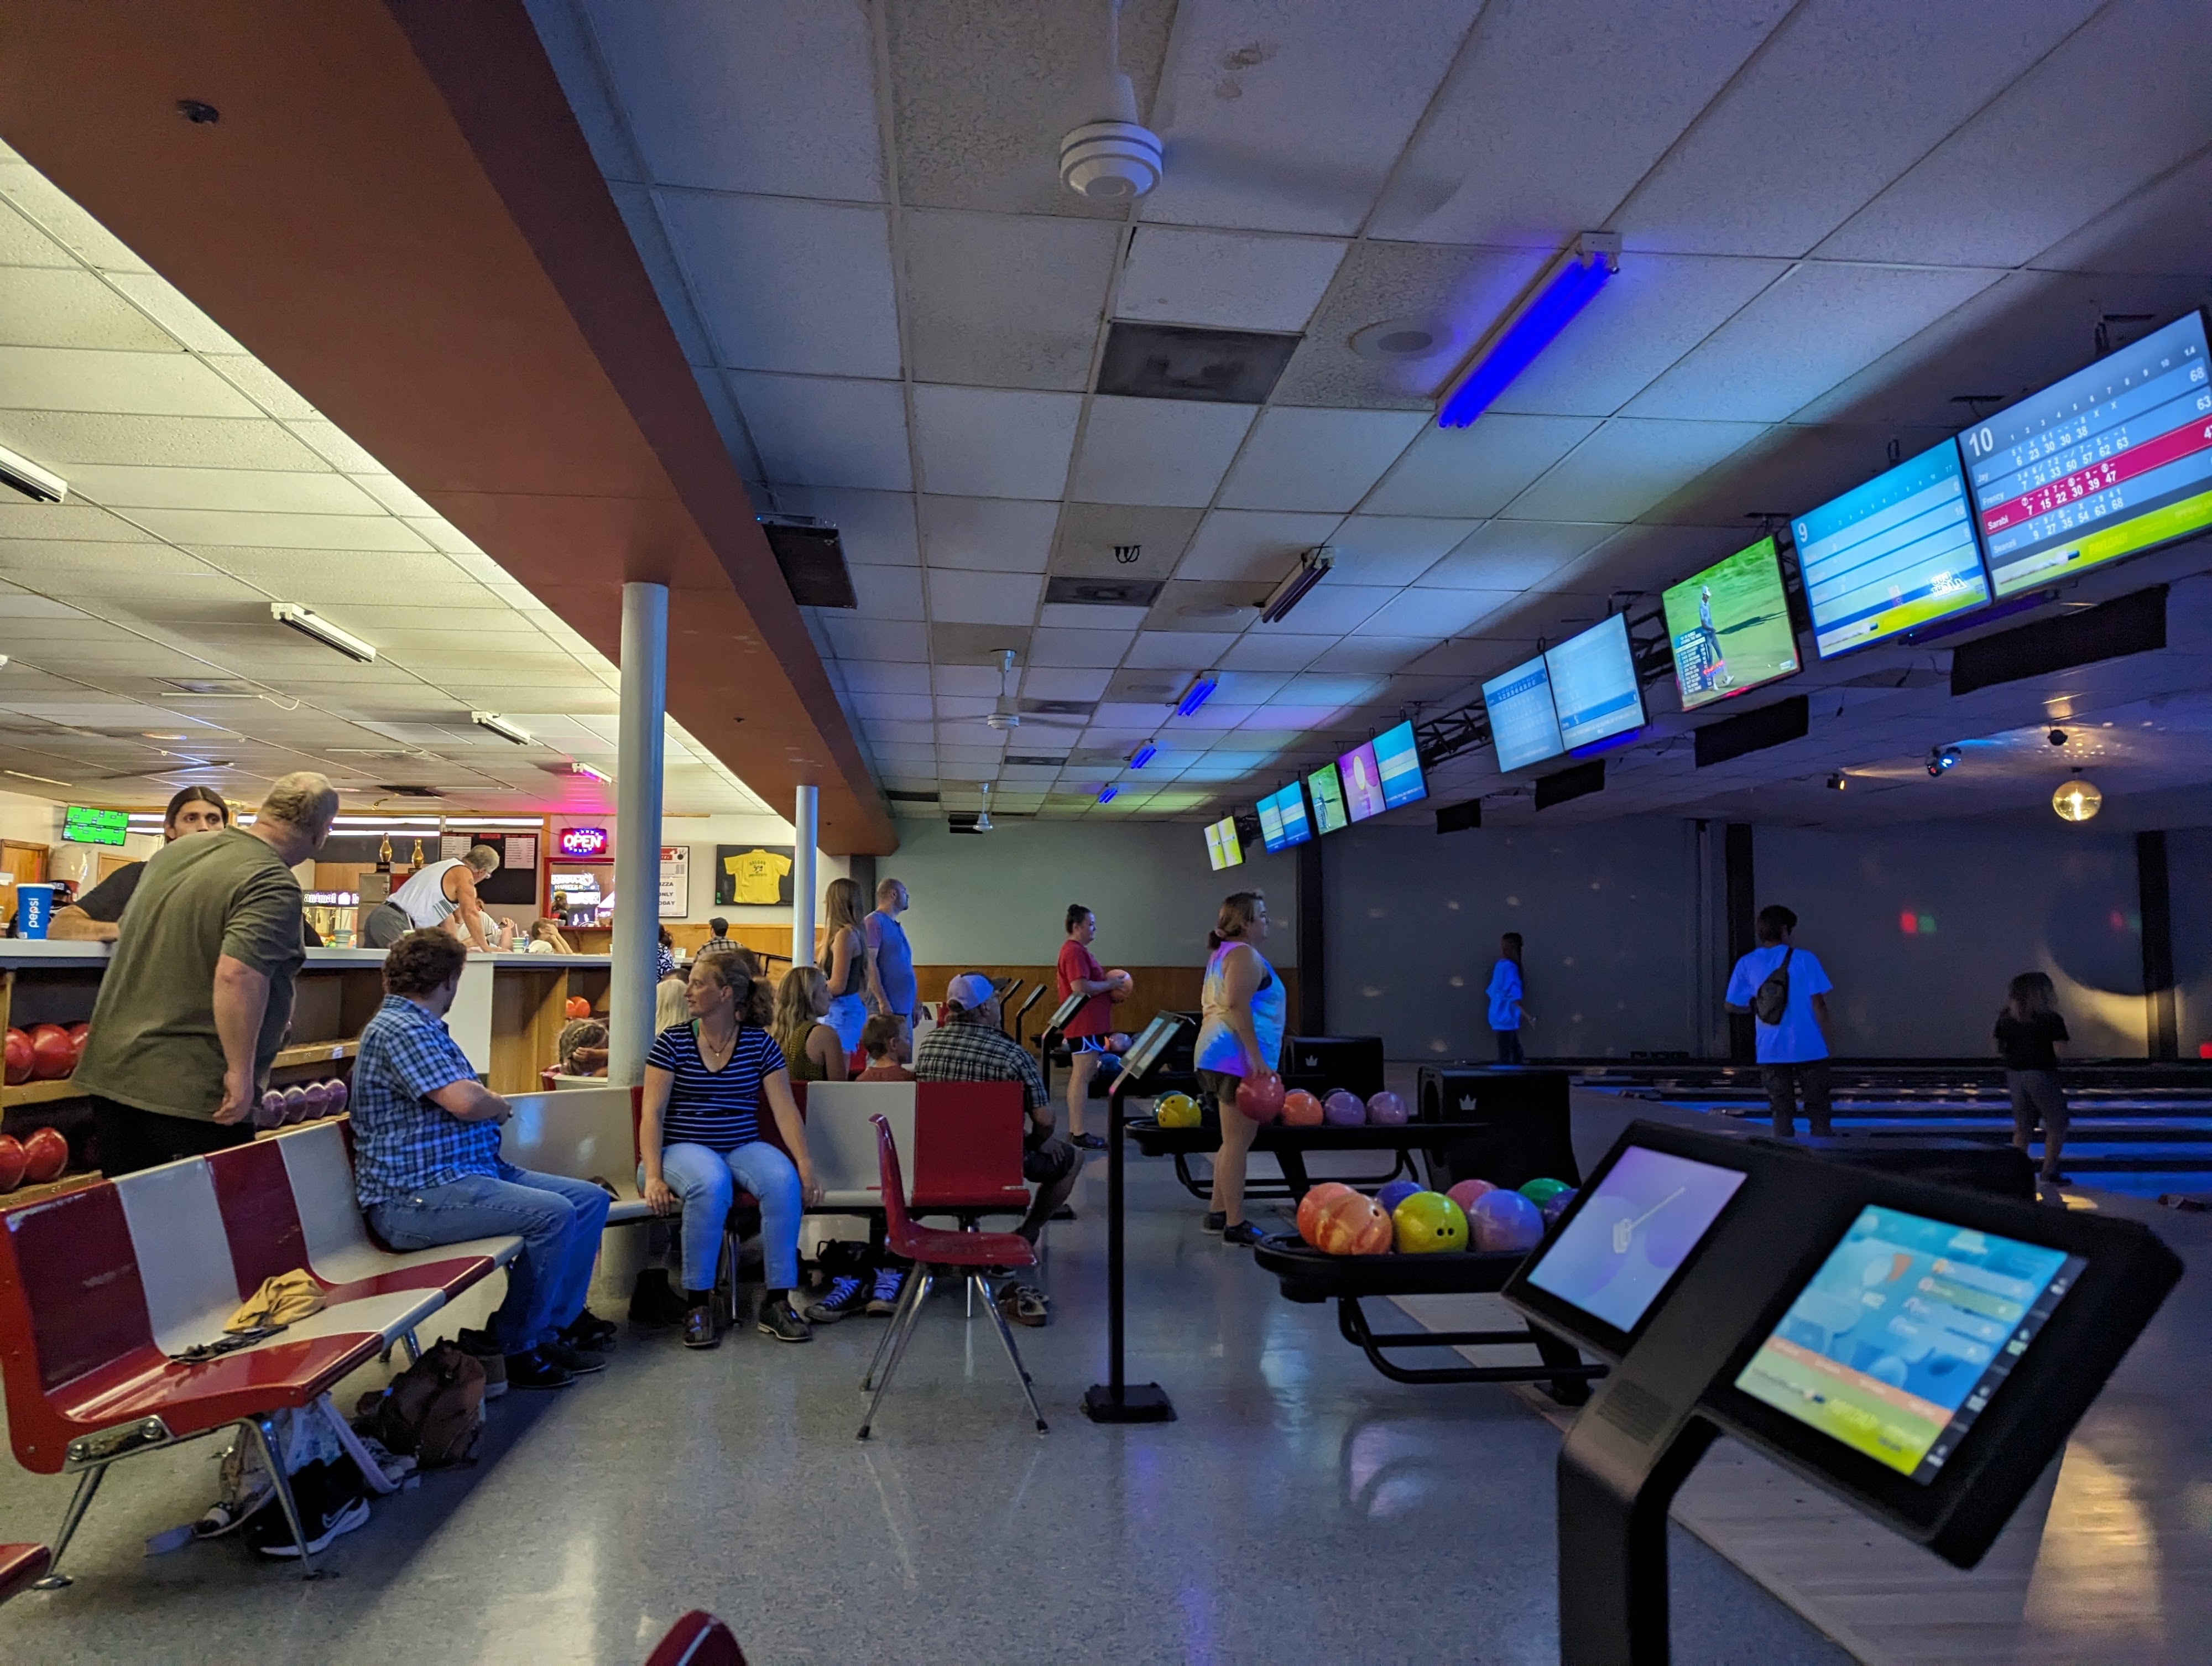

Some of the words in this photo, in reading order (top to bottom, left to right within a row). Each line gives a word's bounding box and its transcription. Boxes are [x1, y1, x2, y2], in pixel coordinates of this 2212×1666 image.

[2161, 359, 2169, 368] 10
[2016, 456, 2022, 466] 6
[2029, 448, 2039, 460] 23
[2044, 441, 2055, 453] 30
[2060, 434, 2071, 445] 30
[2077, 426, 2088, 438] 38
[2190, 367, 2204, 382] 68
[1969, 427, 1994, 456] 10
[2022, 481, 2027, 490] 7
[2035, 473, 2045, 485] 24
[2051, 466, 2061, 478] 33
[2067, 459, 2077, 471] 50
[2083, 452, 2093, 464] 57
[2099, 445, 2111, 456] 62
[2117, 437, 2128, 449] 63
[2197, 395, 2211, 410] 63
[1977, 472, 1989, 482] Jay
[2027, 506, 2033, 516] 7
[2041, 499, 2051, 509] 15
[2056, 492, 2067, 504] 22
[2073, 485, 2083, 497] 30
[2089, 478, 2099, 490] 39
[2106, 471, 2116, 483] 47
[1798, 522, 1808, 543] 9
[1987, 516, 2008, 530] Sarabi
[2033, 530, 2039, 540] 9
[2047, 523, 2056, 535] 27
[2062, 517, 2073, 529] 35
[2079, 511, 2089, 523] 54
[2095, 504, 2106, 516] 63
[2112, 497, 2124, 509] 68
[564, 834, 603, 848] OPEN
[28, 898, 41, 928] pepsi
